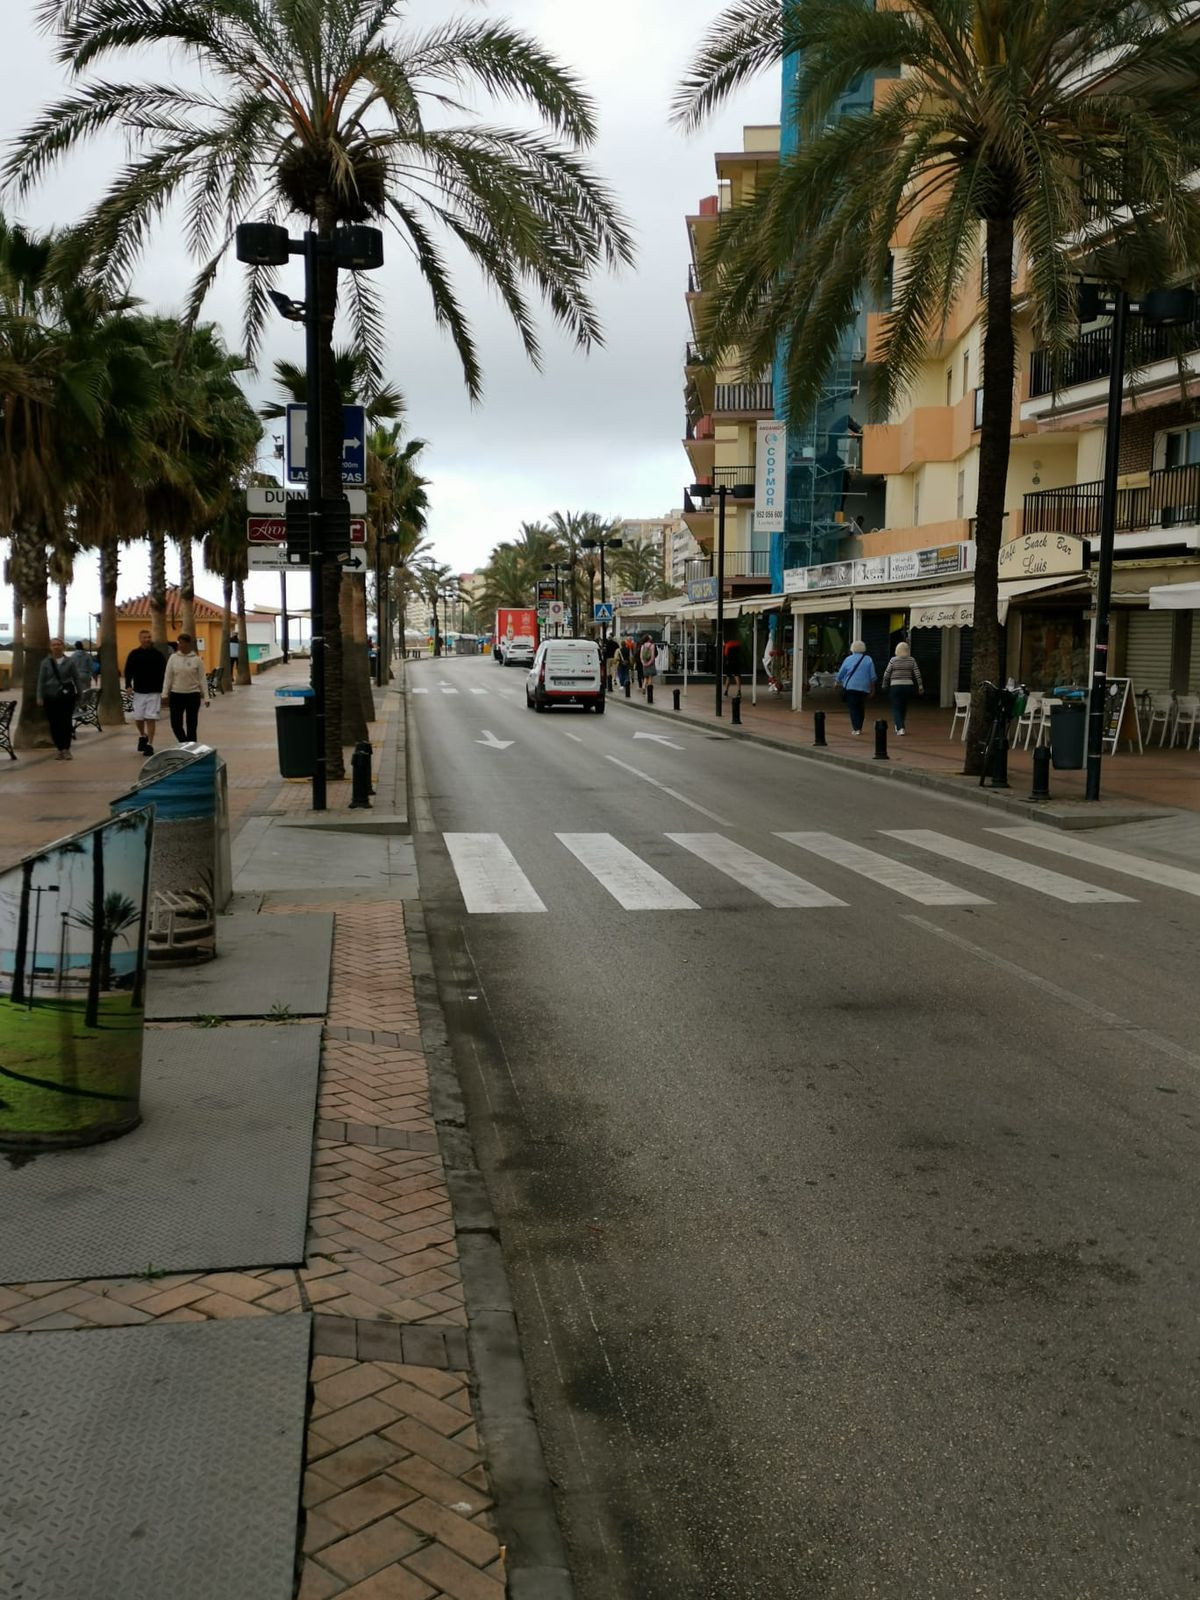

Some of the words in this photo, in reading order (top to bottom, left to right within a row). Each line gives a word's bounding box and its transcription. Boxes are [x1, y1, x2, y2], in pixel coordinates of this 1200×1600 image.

[290, 471, 309, 481] LAS
[766, 447, 776, 506] COPMOR
[999, 544, 1016, 566] Café
[1024, 535, 1048, 551] Snack
[1057, 536, 1072, 555] Bar
[895, 563, 916, 572] Movistar
[1022, 554, 1048, 574] Luis
[920, 611, 934, 623] Café
[937, 610, 956, 621] Snack
